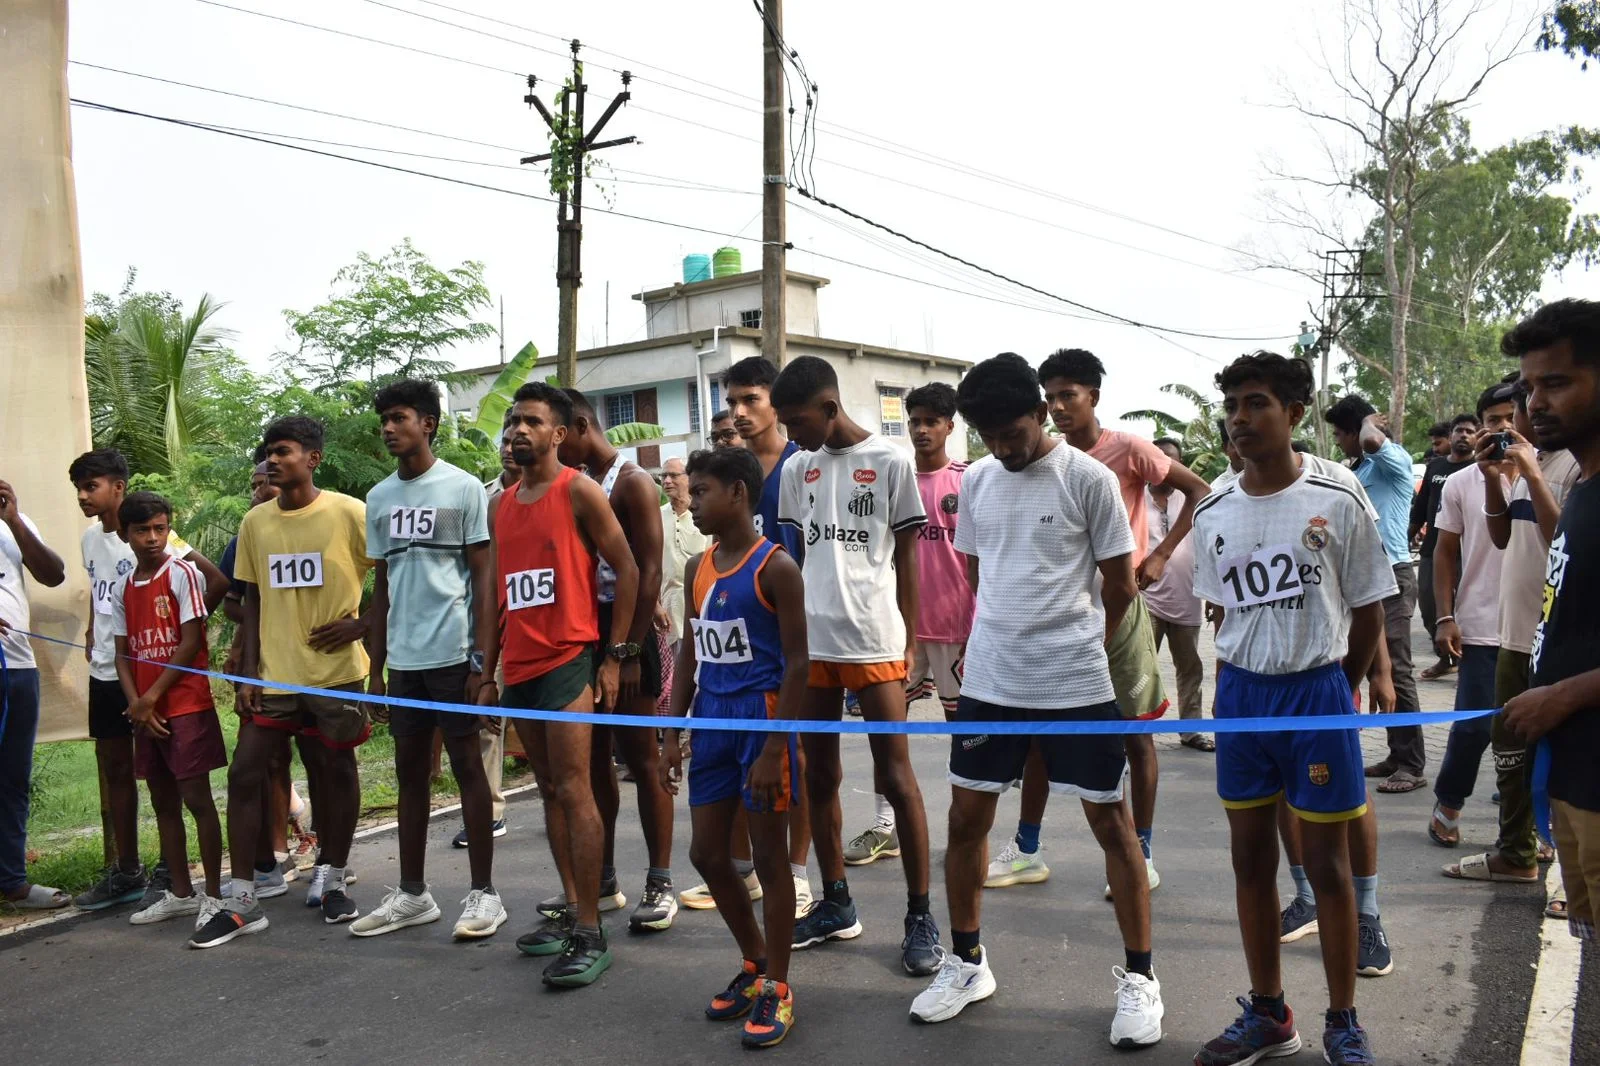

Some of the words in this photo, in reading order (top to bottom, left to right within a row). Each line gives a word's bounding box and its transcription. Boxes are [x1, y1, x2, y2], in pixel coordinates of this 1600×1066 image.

[392, 509, 433, 535] 115
[825, 524, 869, 543] blaze
[271, 559, 315, 583] 110
[1222, 554, 1299, 602] 102
[1297, 564, 1322, 585] es
[506, 571, 553, 603] 105
[129, 627, 178, 652] QATAR
[695, 626, 747, 659] 104
